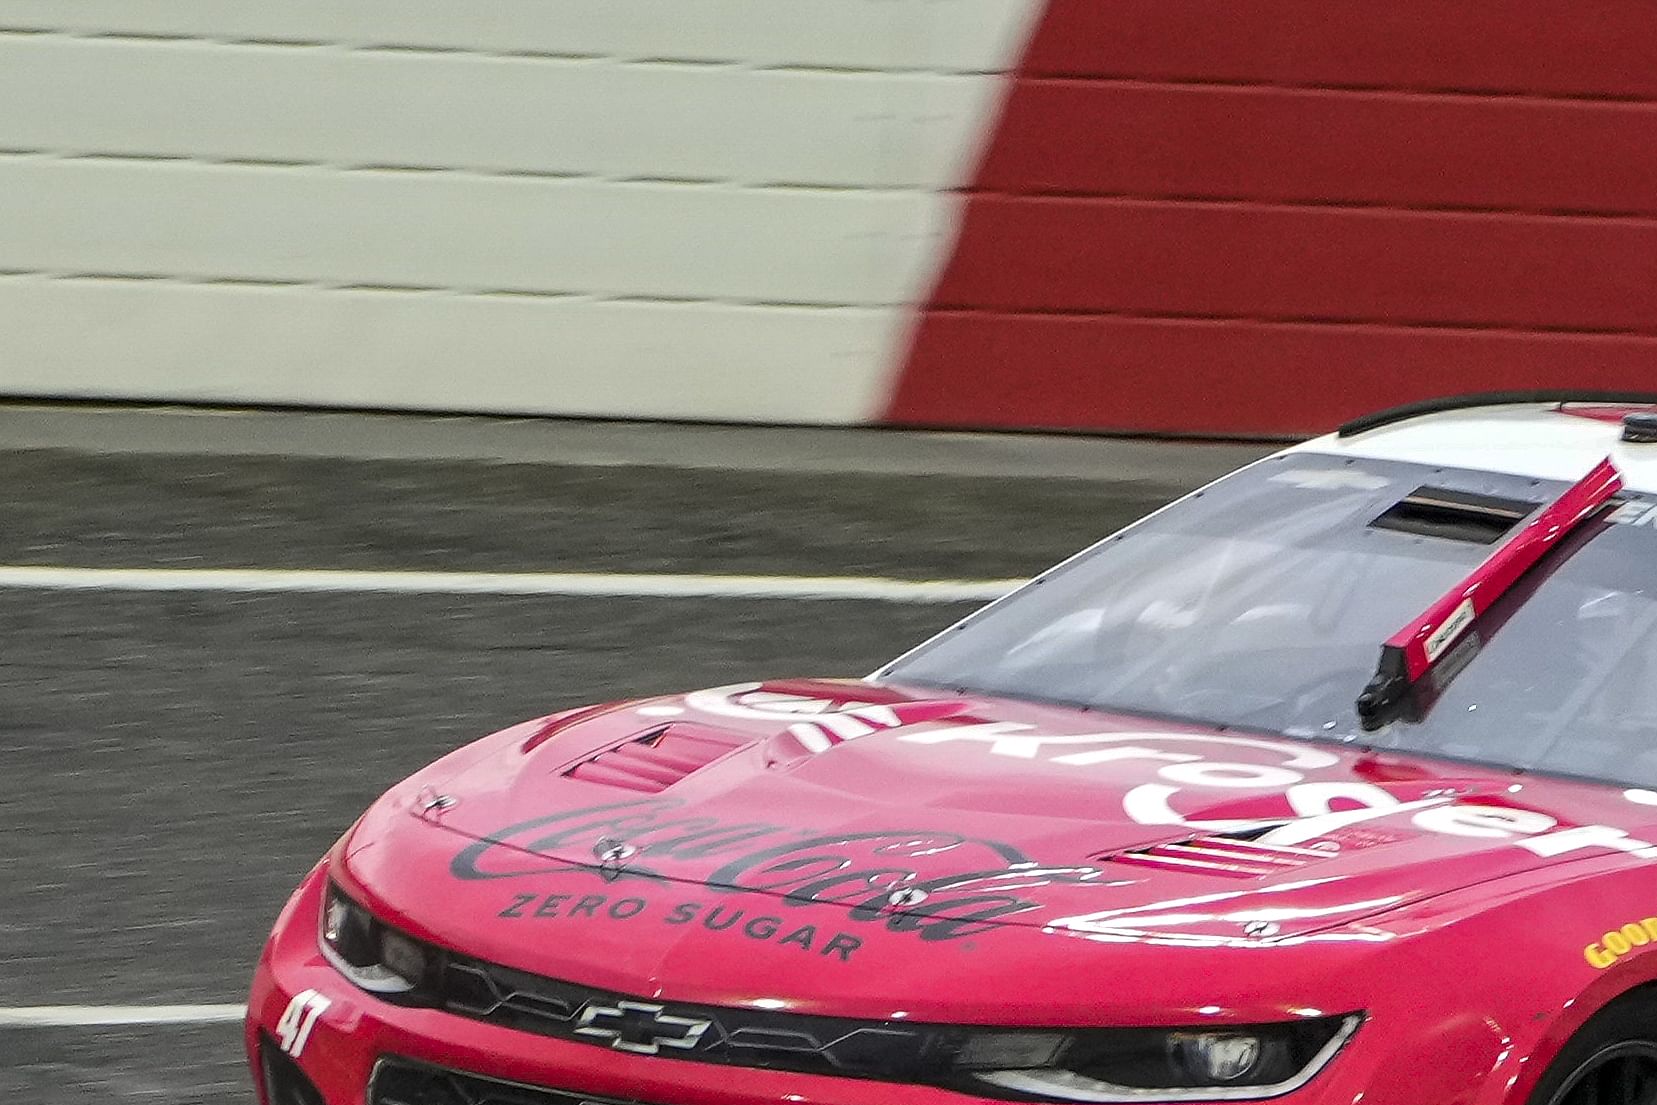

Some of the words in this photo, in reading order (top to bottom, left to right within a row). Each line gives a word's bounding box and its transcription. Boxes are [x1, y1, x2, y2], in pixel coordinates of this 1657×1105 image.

[499, 893, 648, 923] ZERO
[674, 902, 864, 963] SUGAR
[275, 988, 332, 1056] 47
